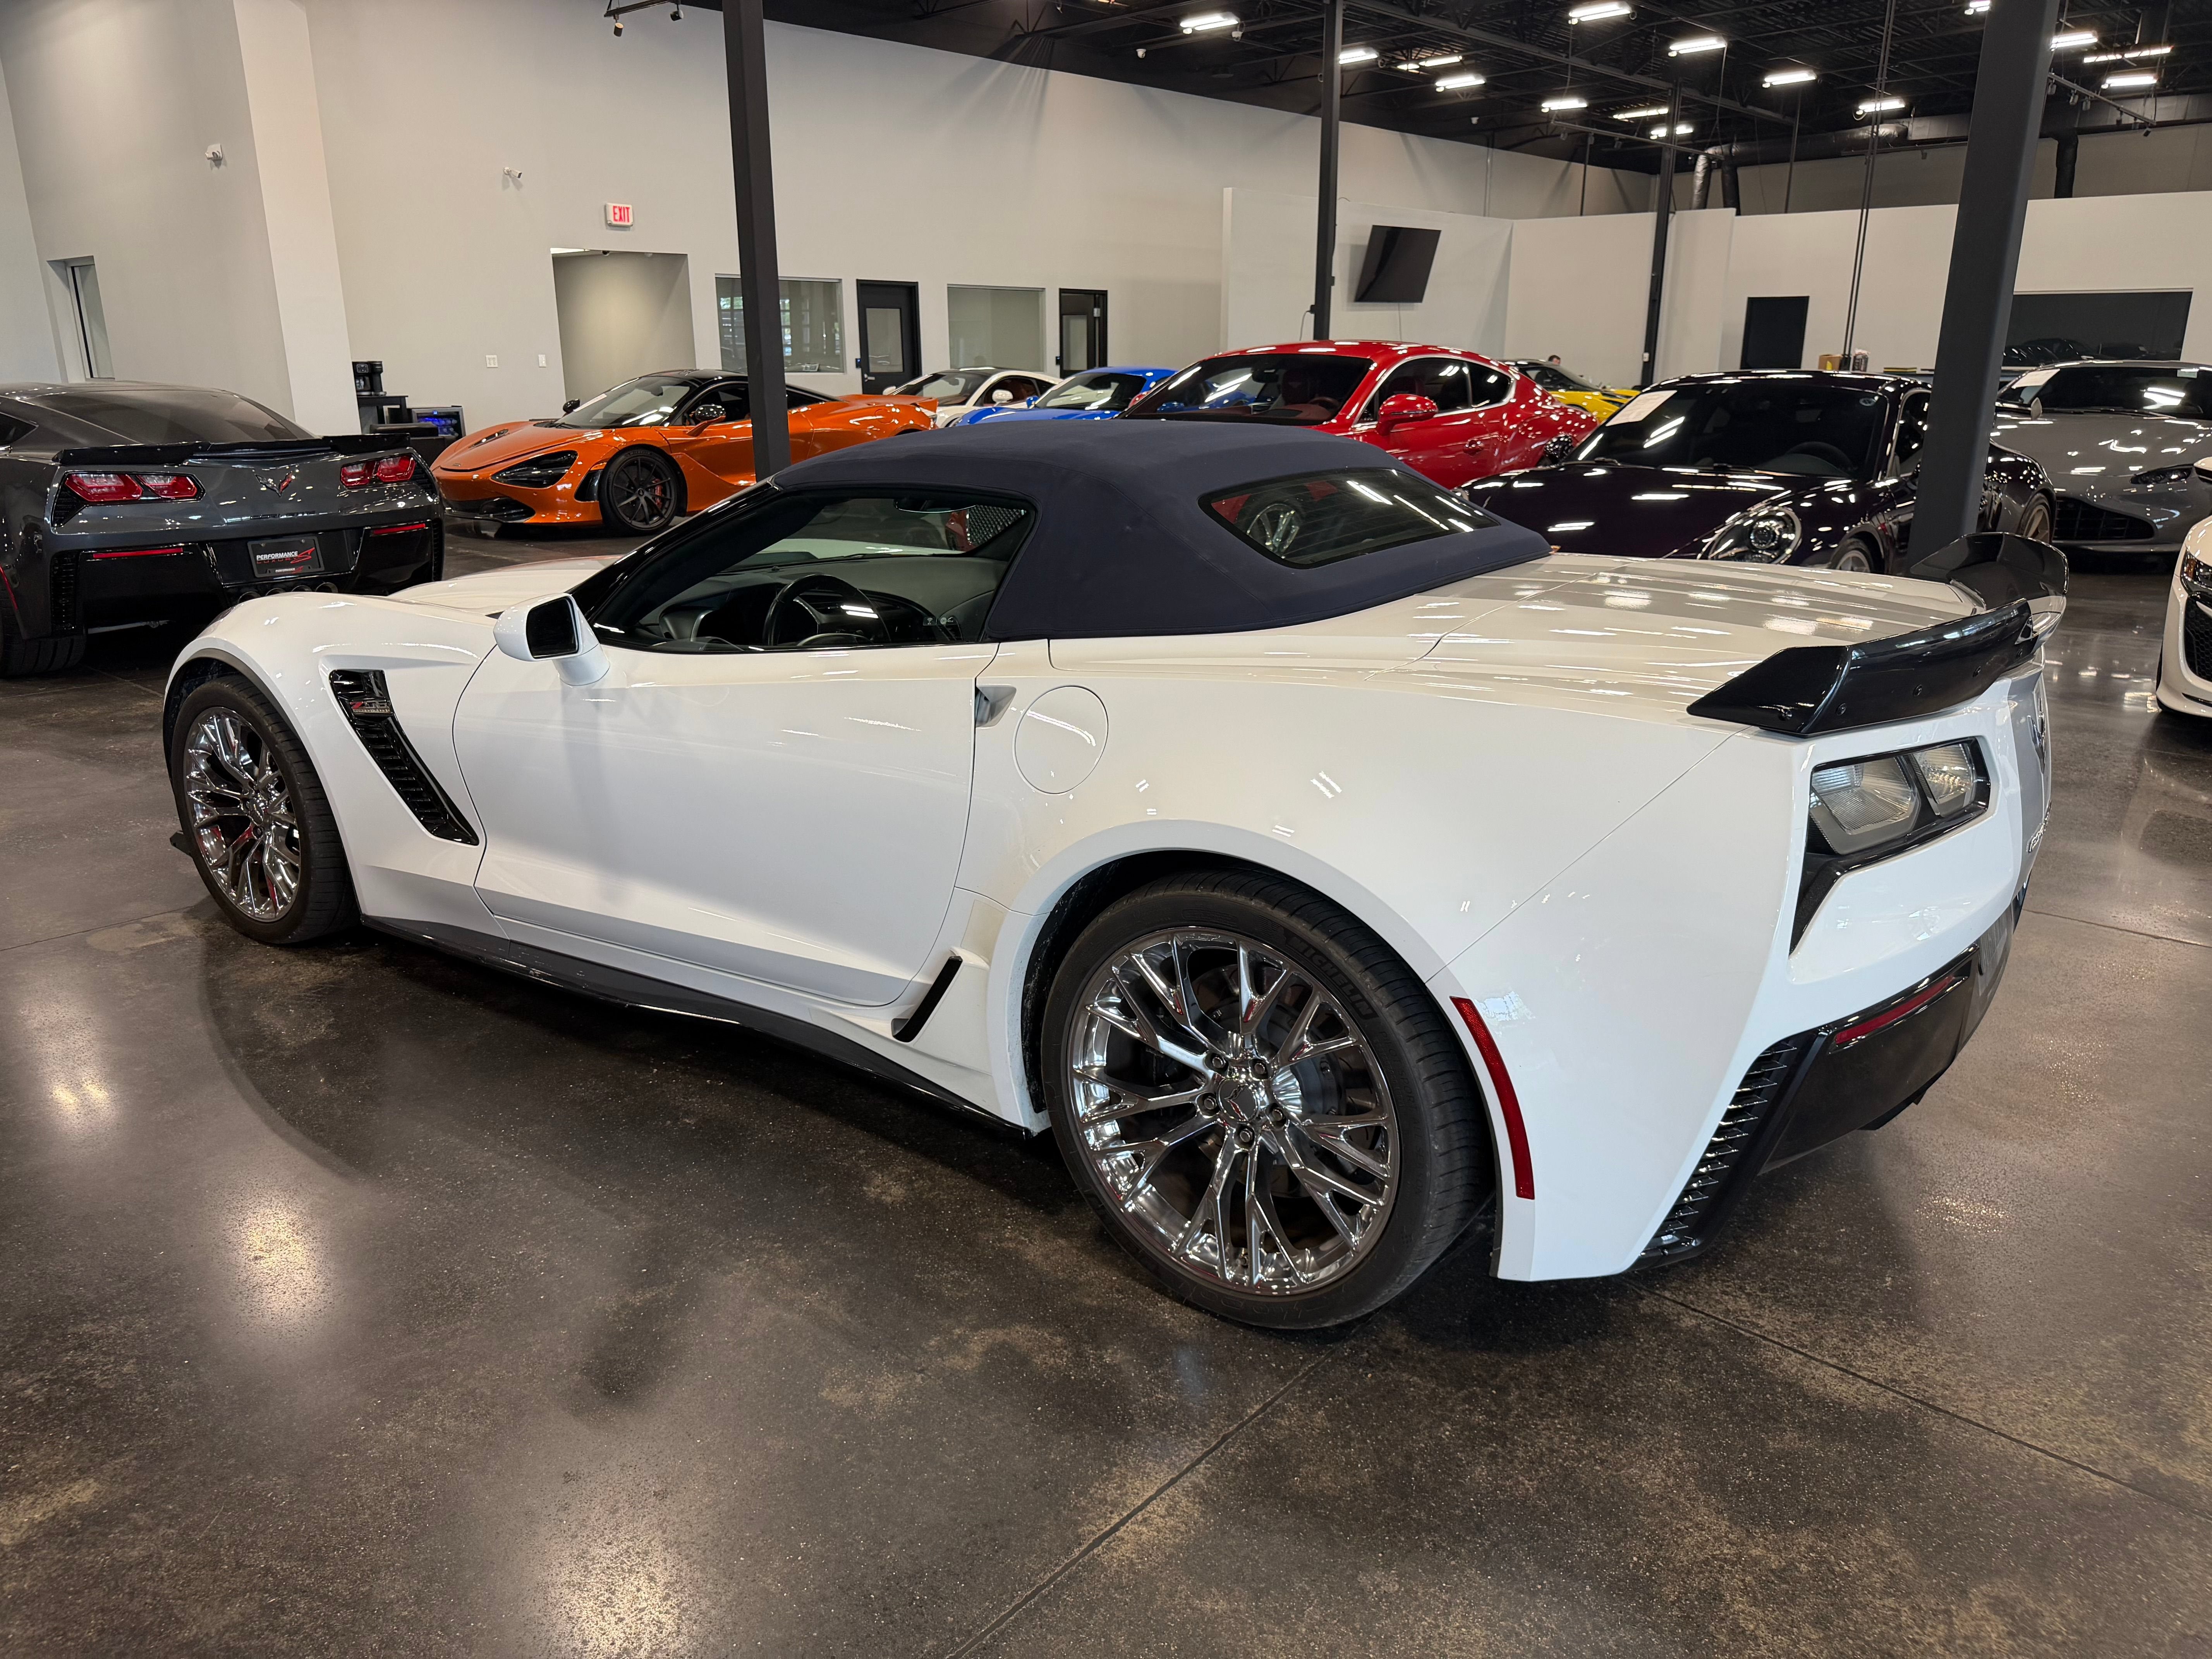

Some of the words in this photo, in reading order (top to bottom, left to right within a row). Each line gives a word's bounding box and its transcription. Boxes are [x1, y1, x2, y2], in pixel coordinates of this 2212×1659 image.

[613, 205, 630, 223] EXIT
[256, 551, 298, 561] PERFORMANCE
[1288, 936, 1373, 1016] MICHELIN
[1379, 1031, 1401, 1064] PILOT
[1398, 1070, 1418, 1110] SPORT
